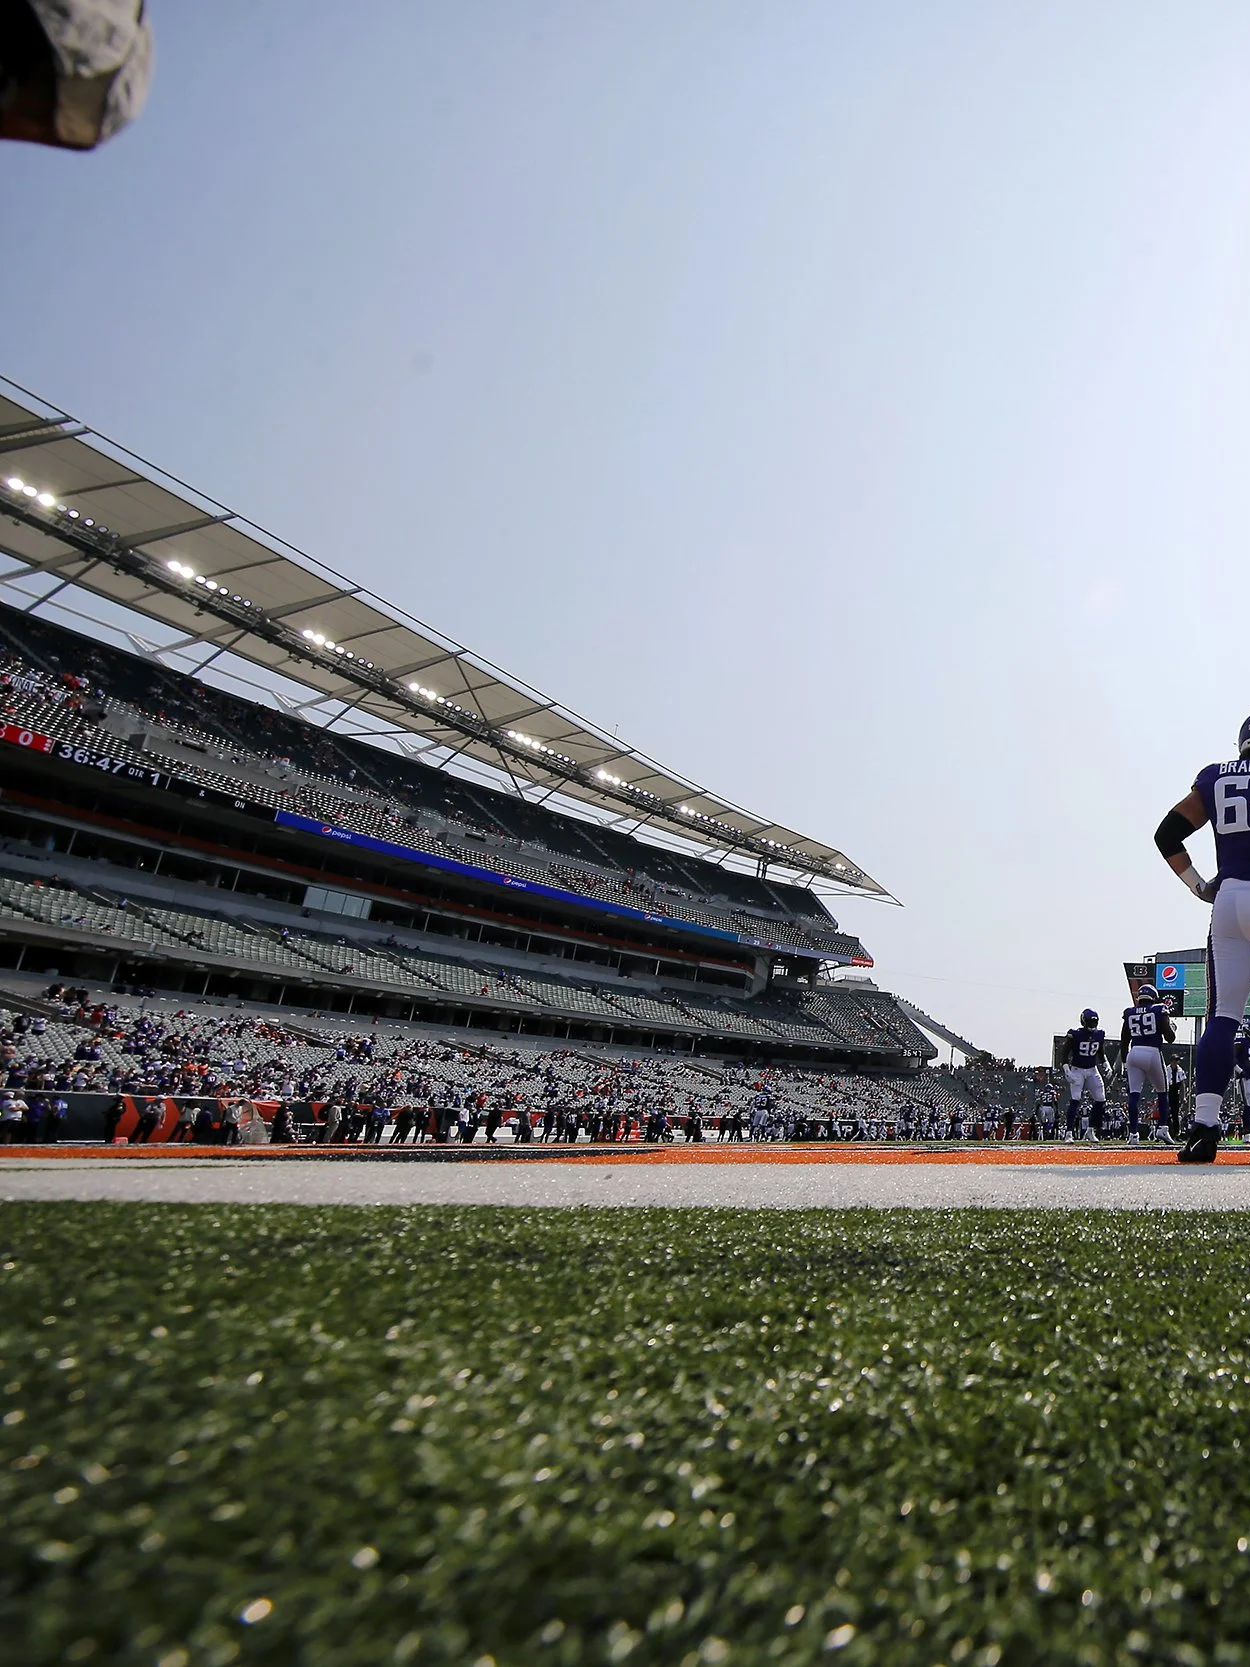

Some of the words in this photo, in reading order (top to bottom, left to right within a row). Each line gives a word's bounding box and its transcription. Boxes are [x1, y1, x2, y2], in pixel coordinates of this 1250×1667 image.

[18, 730, 34, 746] 0
[58, 743, 126, 774] 36:47
[127, 766, 145, 779] QTR
[150, 772, 160, 786] 1
[234, 800, 246, 810] ON
[331, 830, 352, 840] pepsi
